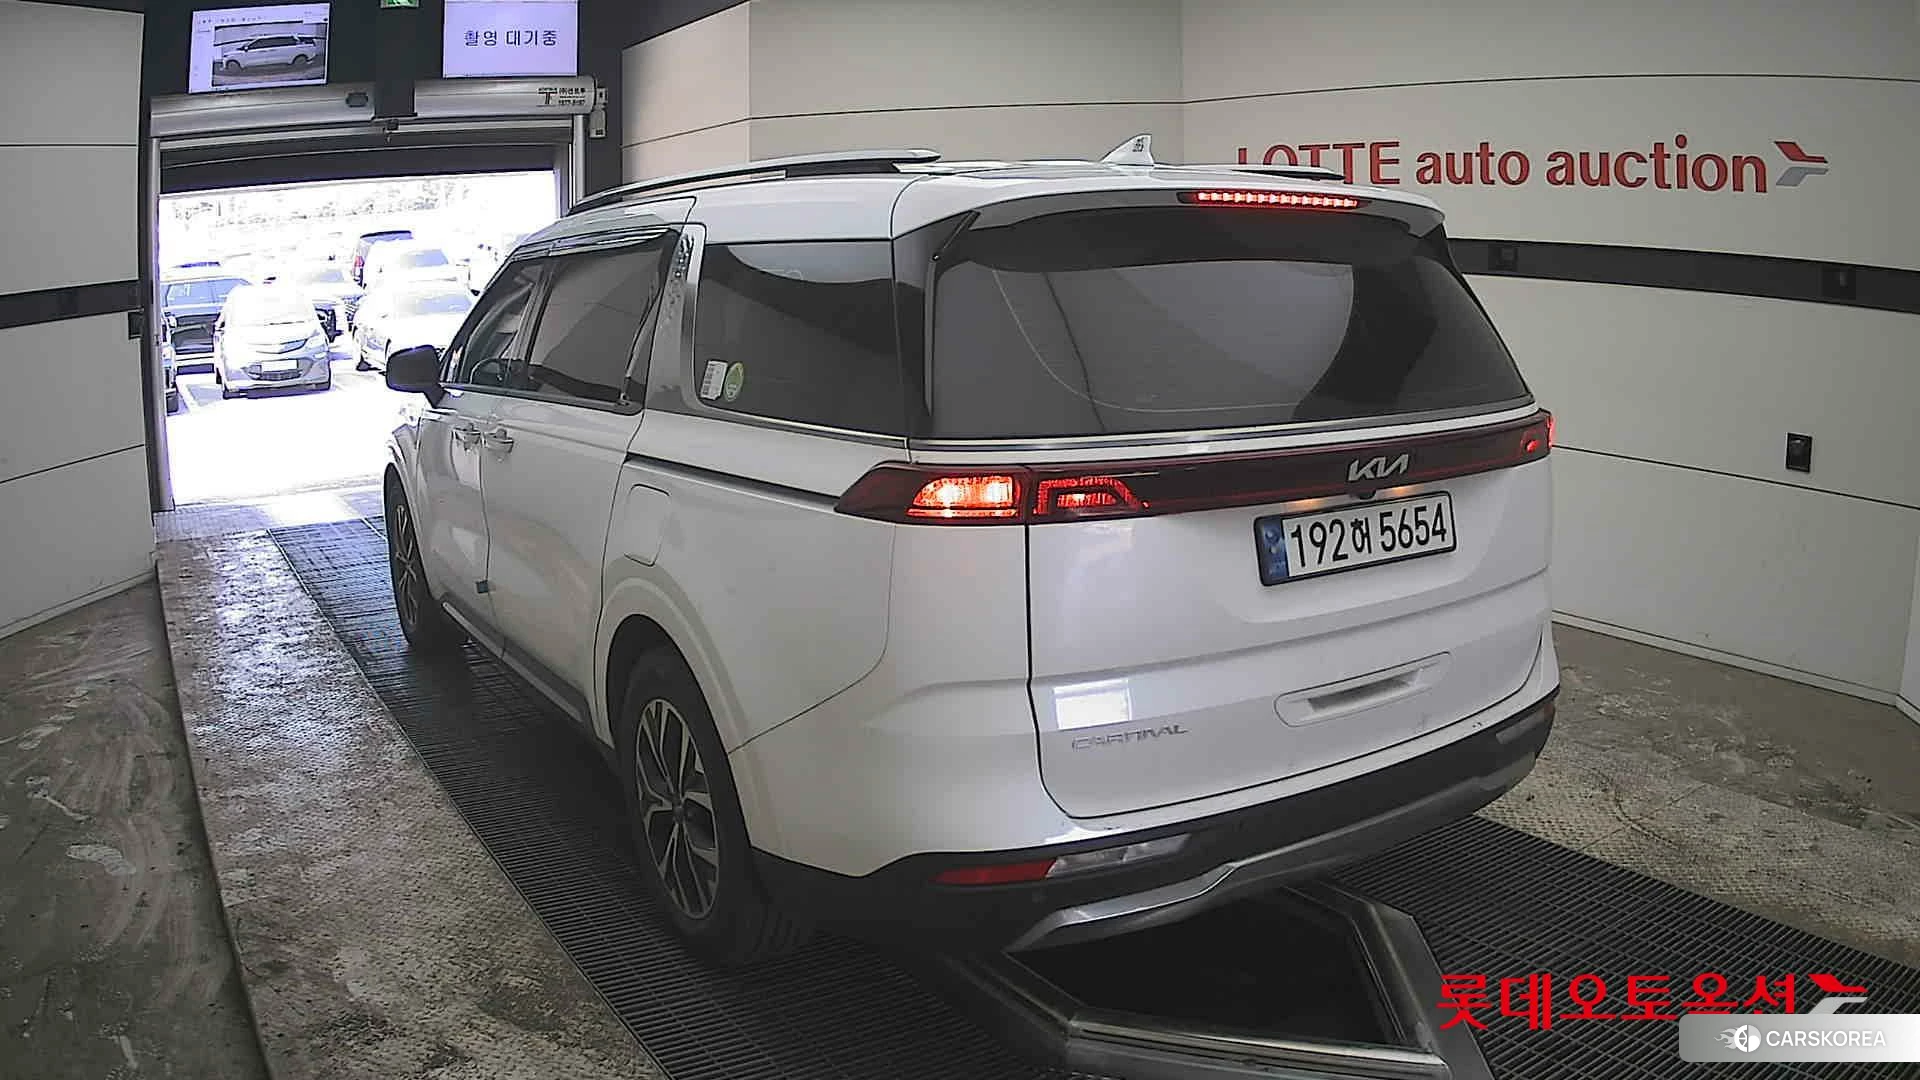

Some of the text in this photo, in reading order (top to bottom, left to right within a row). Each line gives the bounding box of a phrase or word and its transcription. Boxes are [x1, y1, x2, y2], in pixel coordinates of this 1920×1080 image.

[506, 30, 557, 46] 대기중
[1416, 140, 1530, 185] auto
[1547, 135, 1767, 193] auction
[1379, 503, 1447, 552] 5654
